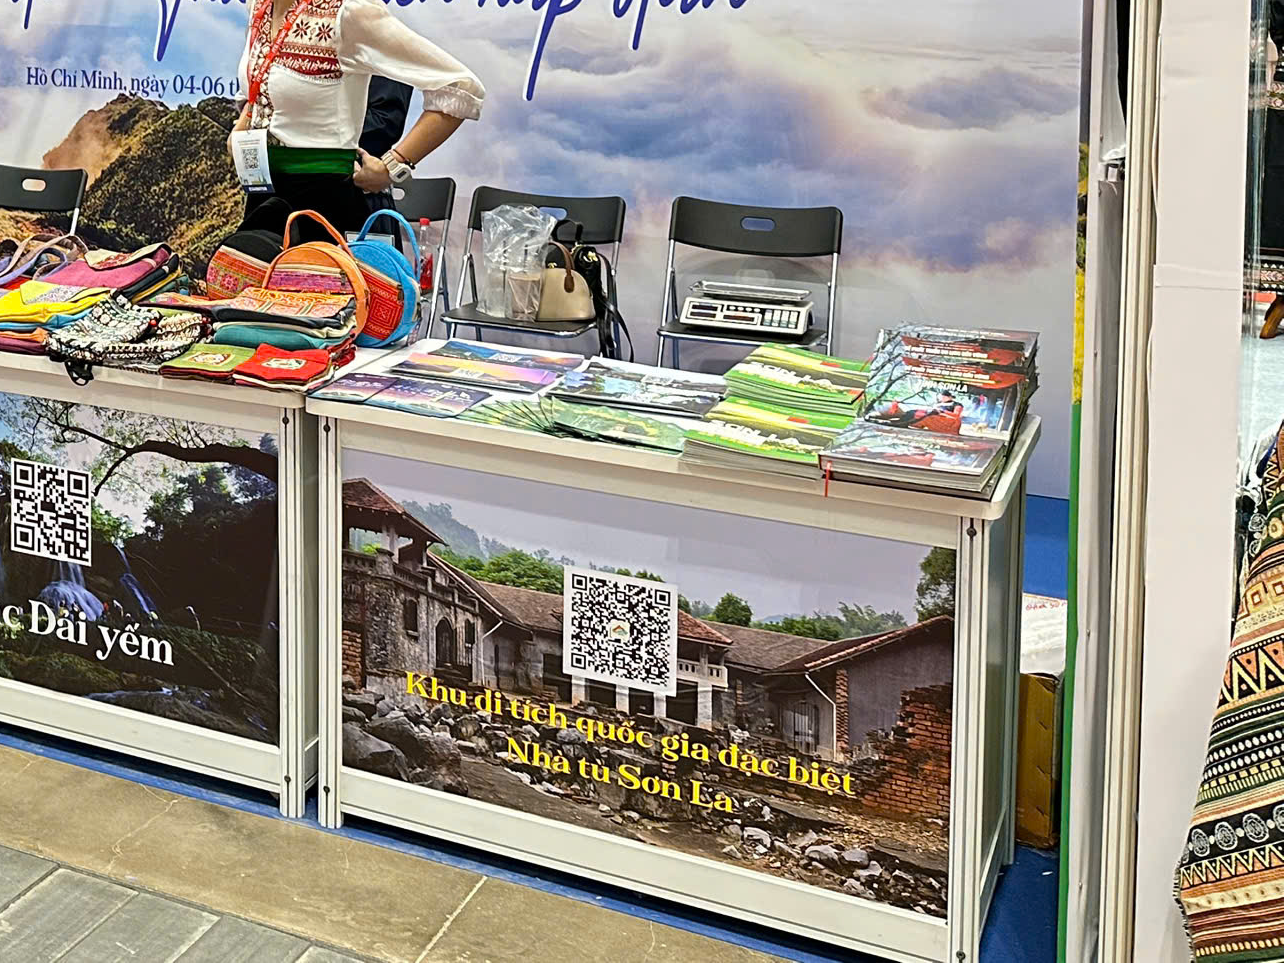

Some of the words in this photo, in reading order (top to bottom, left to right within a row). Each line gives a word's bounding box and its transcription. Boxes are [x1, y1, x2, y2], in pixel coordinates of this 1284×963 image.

[27, 65, 48, 86] Hồ
[51, 68, 77, 88] Chí
[81, 70, 127, 92] Minh,
[130, 74, 169, 99] ngày
[173, 73, 226, 96] 04-06
[96, 623, 175, 667] yếm
[404, 670, 467, 707] Khu
[474, 689, 503, 716] di
[510, 697, 568, 730] tích
[575, 719, 654, 748] quốc
[660, 732, 711, 763] gia
[718, 742, 780, 778] đặc
[787, 756, 857, 796] biệt
[506, 737, 572, 775] Nhà
[577, 756, 612, 784] tù
[617, 763, 683, 803] Sơn
[689, 779, 734, 814] La
